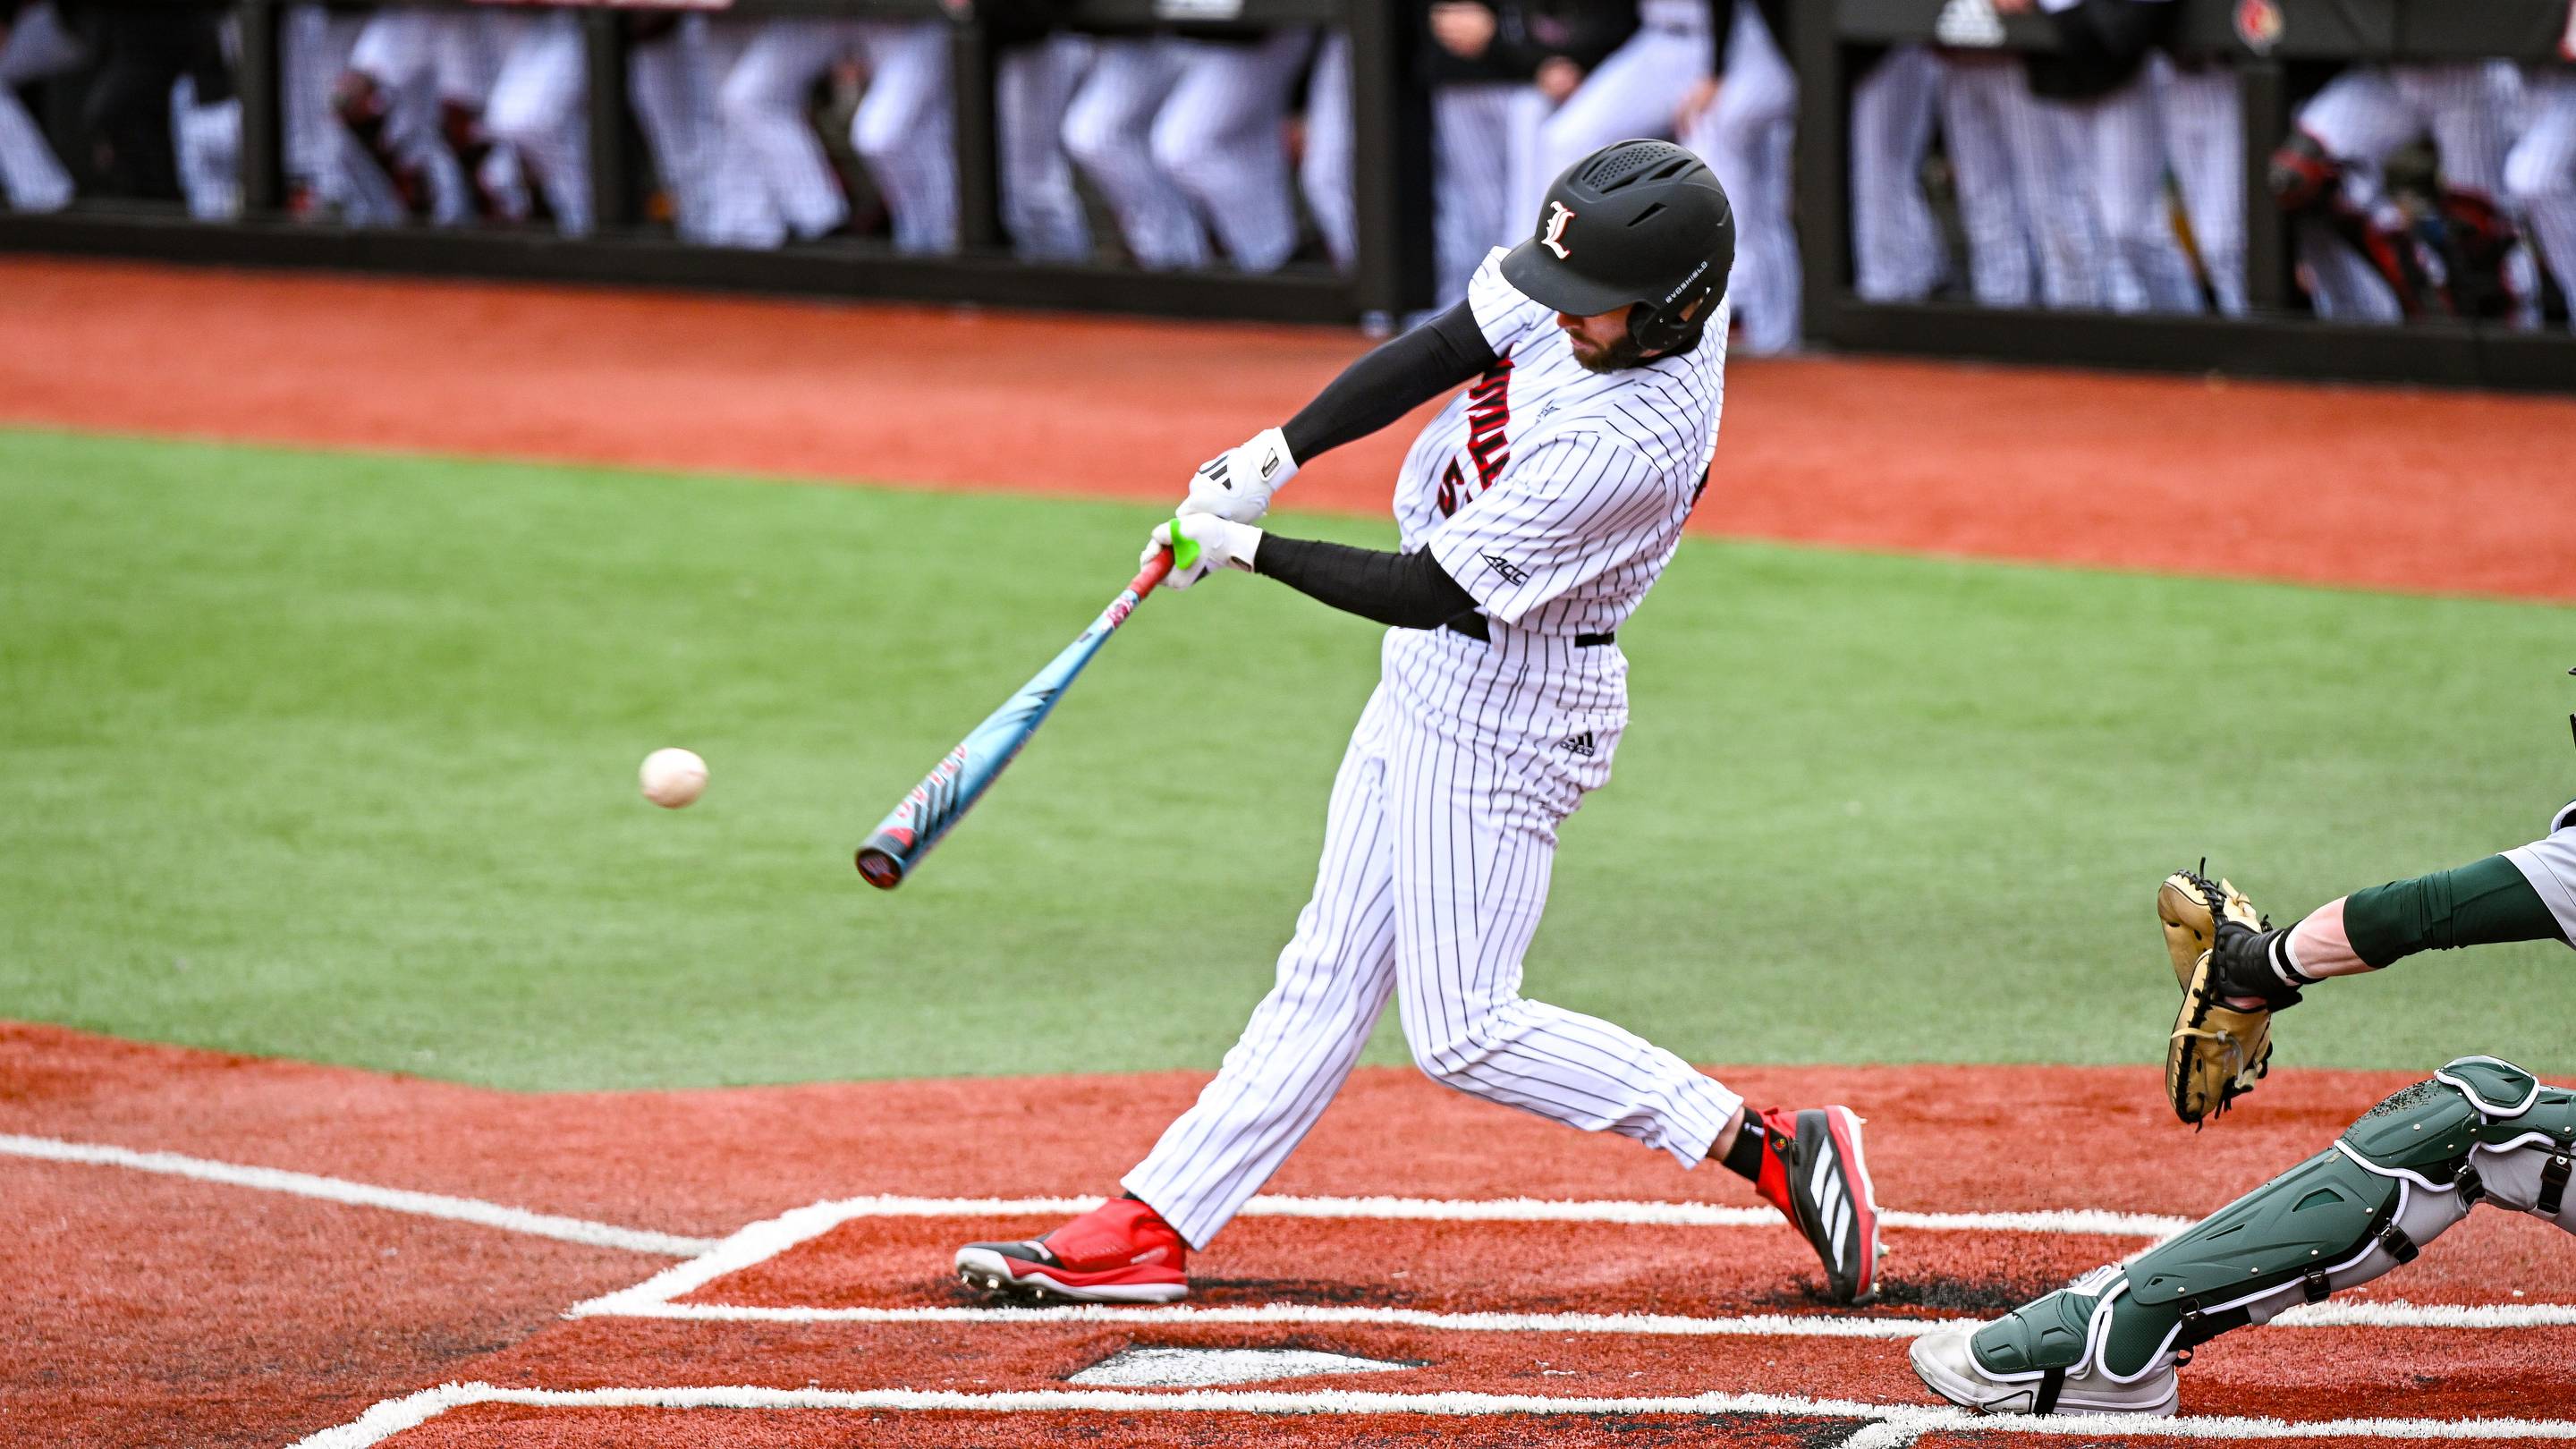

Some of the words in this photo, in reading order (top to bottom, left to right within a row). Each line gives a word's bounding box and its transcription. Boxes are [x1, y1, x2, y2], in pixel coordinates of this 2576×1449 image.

[1540, 200, 1577, 262] L
[1665, 260, 1708, 304] EVOSHIELD
[1478, 549, 1530, 587] ACC
